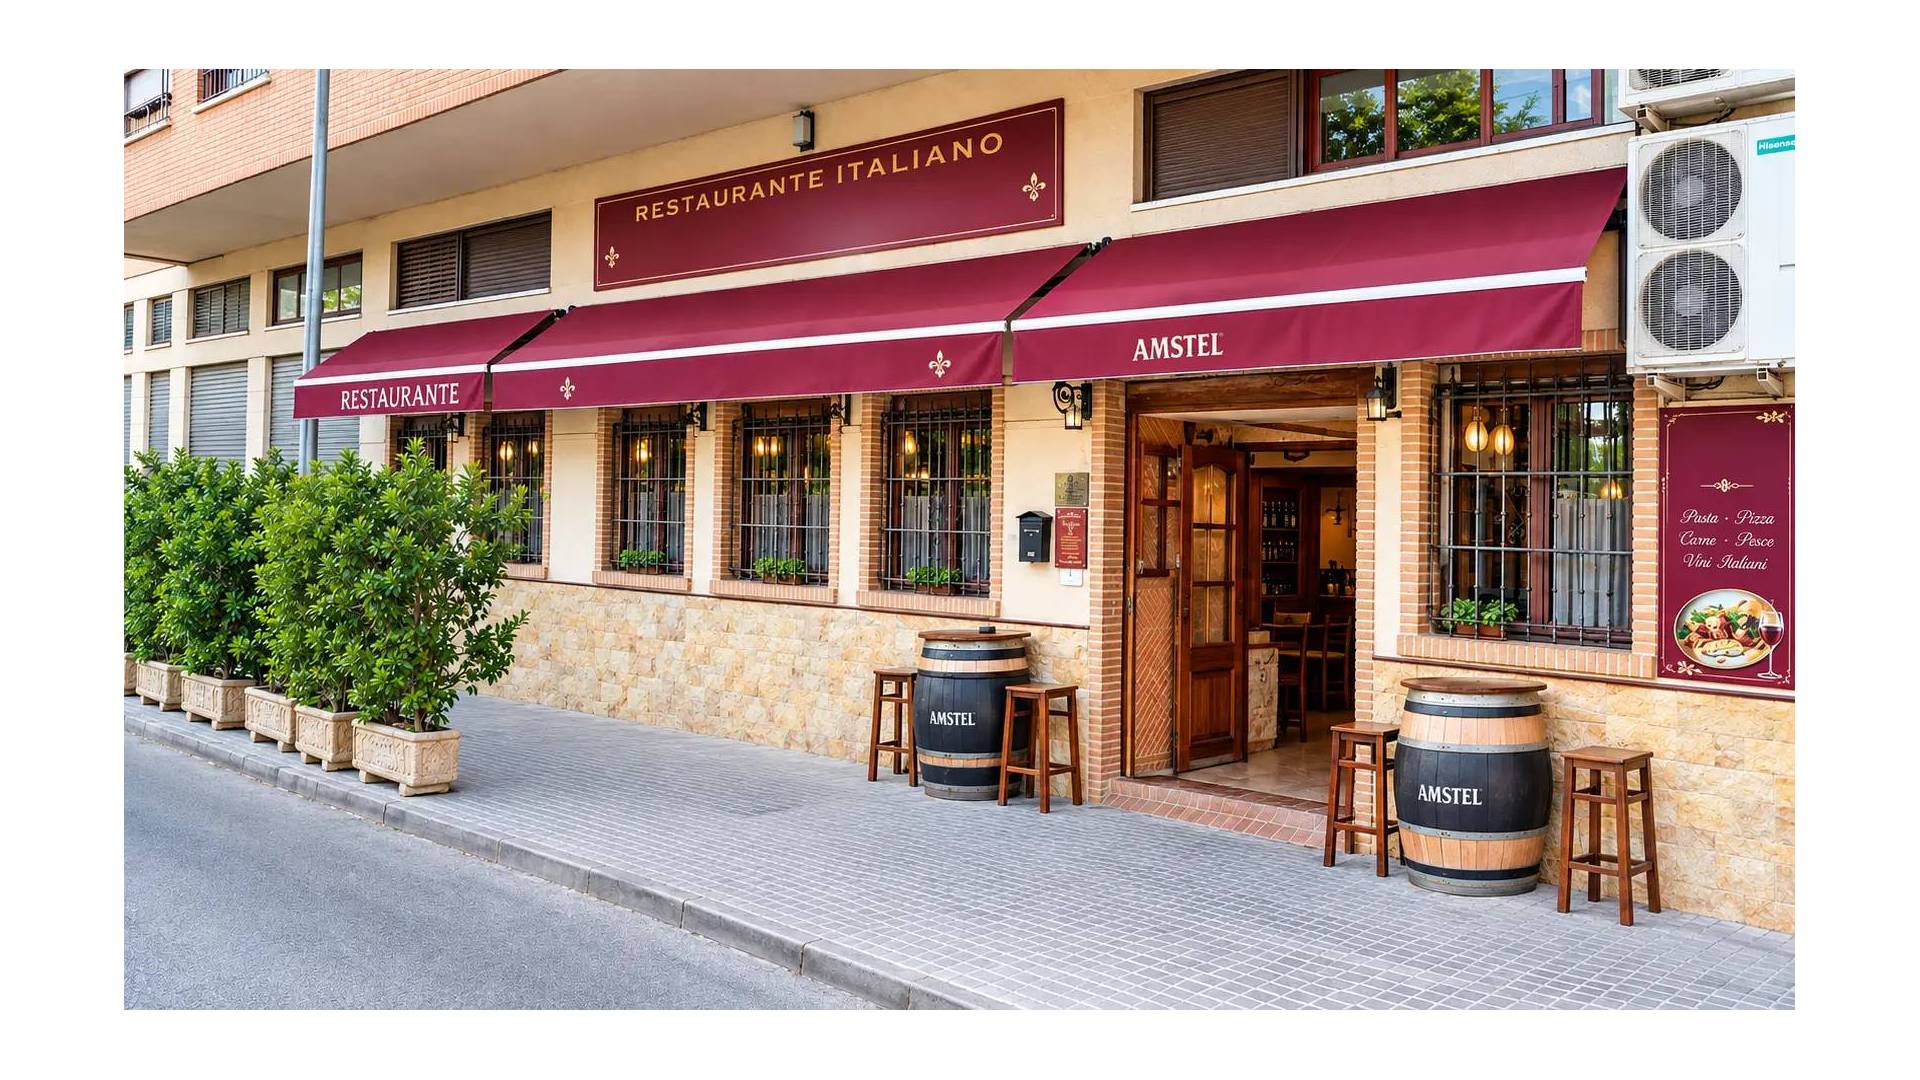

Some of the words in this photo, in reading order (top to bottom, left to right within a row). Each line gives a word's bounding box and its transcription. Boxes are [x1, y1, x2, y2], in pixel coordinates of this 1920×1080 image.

[635, 169, 824, 222] RESTAURANTE
[837, 132, 1003, 184] ITALIANO
[1132, 332, 1224, 361] AMSTEL
[340, 382, 459, 410] RESTAURANTE
[1680, 508, 1720, 524] Pasta
[1734, 509, 1775, 525] Pizza
[1679, 530, 1717, 546] Carne
[1735, 531, 1775, 547] Pesce
[1683, 553, 1713, 568] Vini
[1716, 554, 1768, 570] Italiani
[929, 710, 976, 726] AMSTEL
[1418, 784, 1483, 806] AMSTEL
